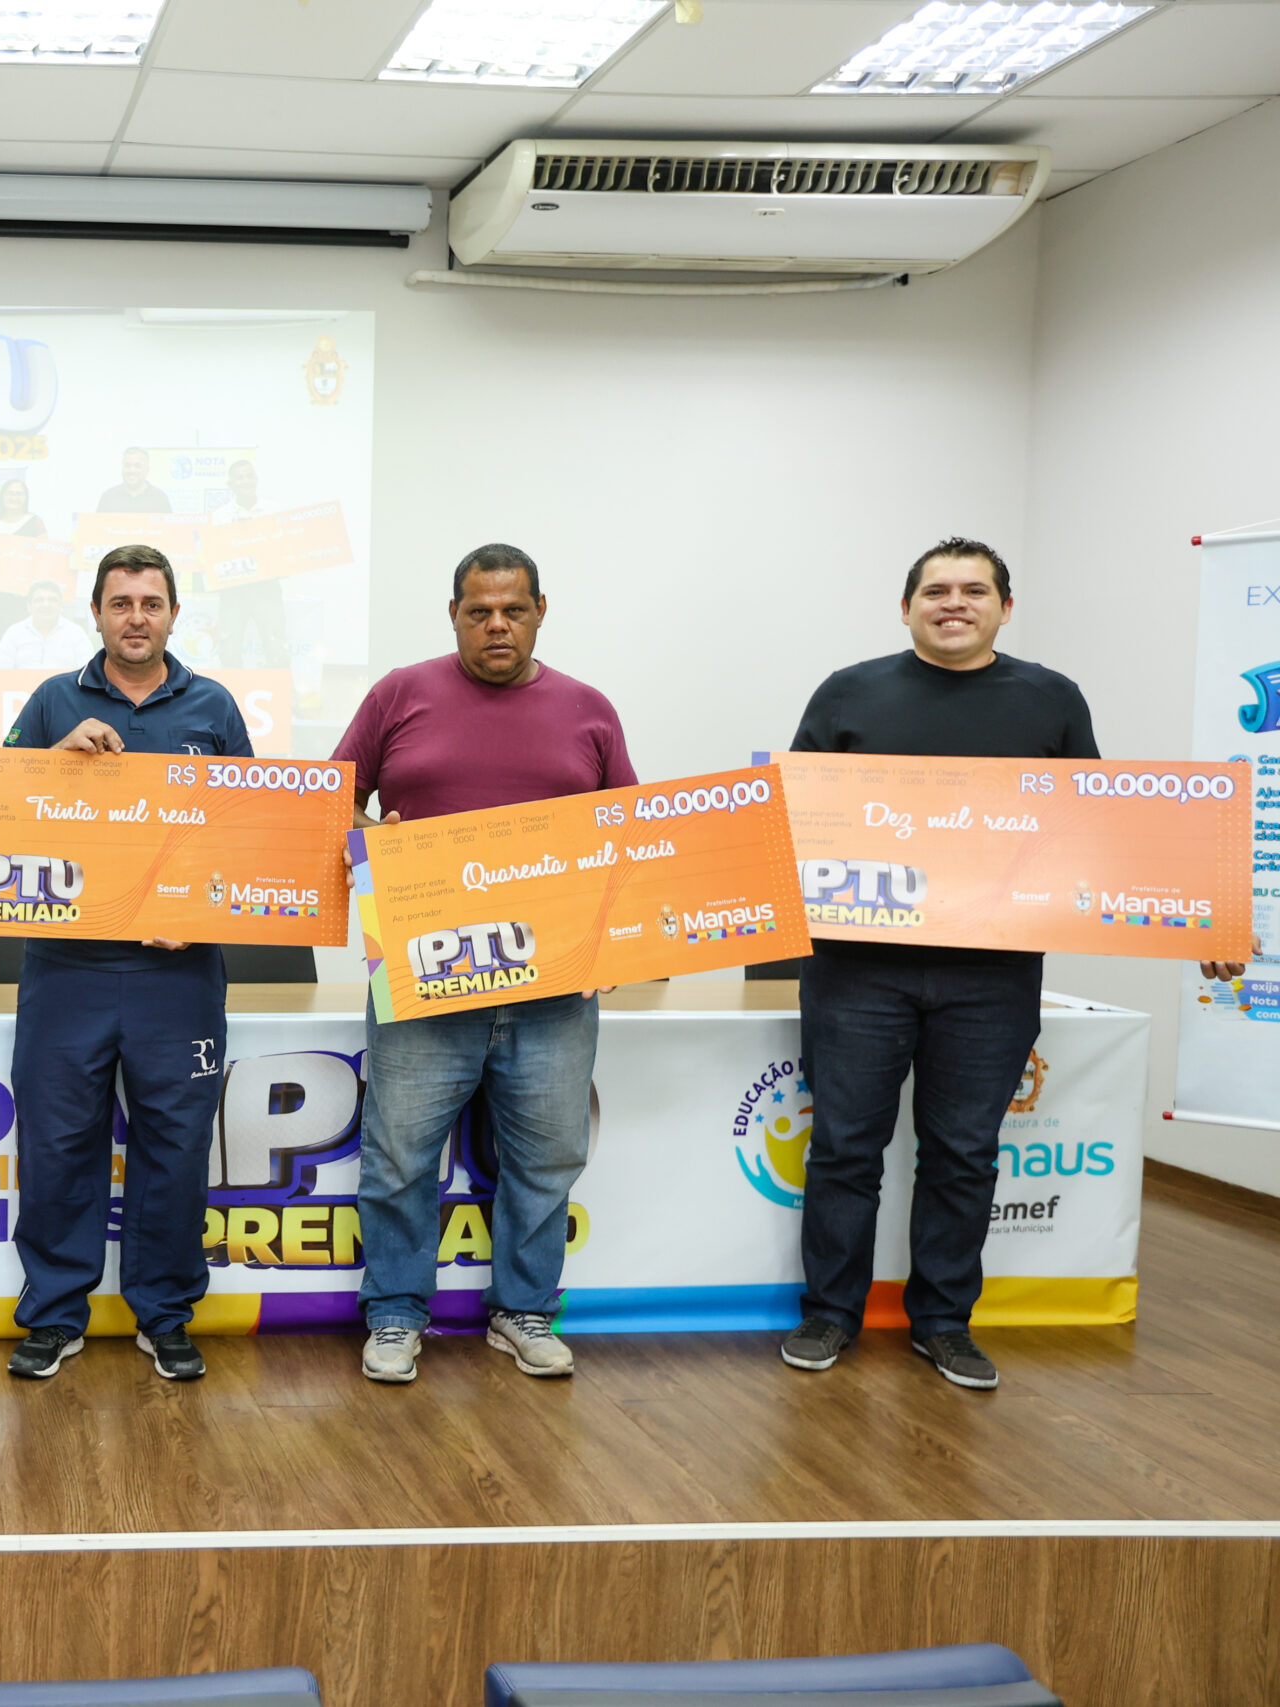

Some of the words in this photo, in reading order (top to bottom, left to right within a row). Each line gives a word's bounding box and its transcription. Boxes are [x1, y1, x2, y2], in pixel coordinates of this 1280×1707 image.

[20, 757, 50, 766] Agência
[59, 758, 84, 766] Conta
[167, 763, 197, 787] R$
[206, 763, 342, 796] 30.000,00
[1020, 772, 1054, 795] R$
[1071, 771, 1235, 803] 10.000,00
[25, 796, 100, 821] Trinta
[108, 798, 149, 823] mil
[158, 806, 206, 826] reais
[594, 802, 625, 829] R$
[634, 778, 771, 822] 40.000,00
[379, 837, 403, 848] Comp
[414, 831, 438, 841] Banco
[447, 825, 478, 837] Agência
[486, 819, 511, 829] Conta
[519, 813, 550, 825] Cheque
[862, 801, 917, 839] Dez
[927, 806, 974, 829] mil
[983, 811, 1039, 833] reais
[462, 854, 568, 892] Quarenta
[577, 840, 619, 871] mil
[626, 839, 676, 863] reais
[156, 883, 191, 894] Semef
[230, 883, 319, 905] Manaus
[387, 883, 412, 894] Pague
[413, 881, 427, 891] por
[429, 878, 446, 887] este
[389, 892, 417, 903] cheque
[426, 887, 455, 899] quantia
[1012, 890, 1051, 901] Semef
[392, 914, 404, 923] Ao
[407, 908, 442, 922] portador
[804, 903, 925, 927] REMIADO
[1101, 891, 1212, 916] Manaus
[608, 922, 642, 937] Semef
[683, 903, 774, 932] Manaus
[407, 921, 536, 979] IPTU
[414, 964, 539, 1001] PREMIADO
[1251, 982, 1280, 994] exija
[1250, 996, 1278, 1006] Nota
[733, 1061, 795, 1136] EDUCAÇÃO
[1000, 1118, 1039, 1129] eitura
[1043, 1117, 1060, 1127] de
[992, 1141, 1115, 1178] naus
[990, 1195, 1061, 1221] emef
[1012, 1224, 1054, 1234] Municipal
